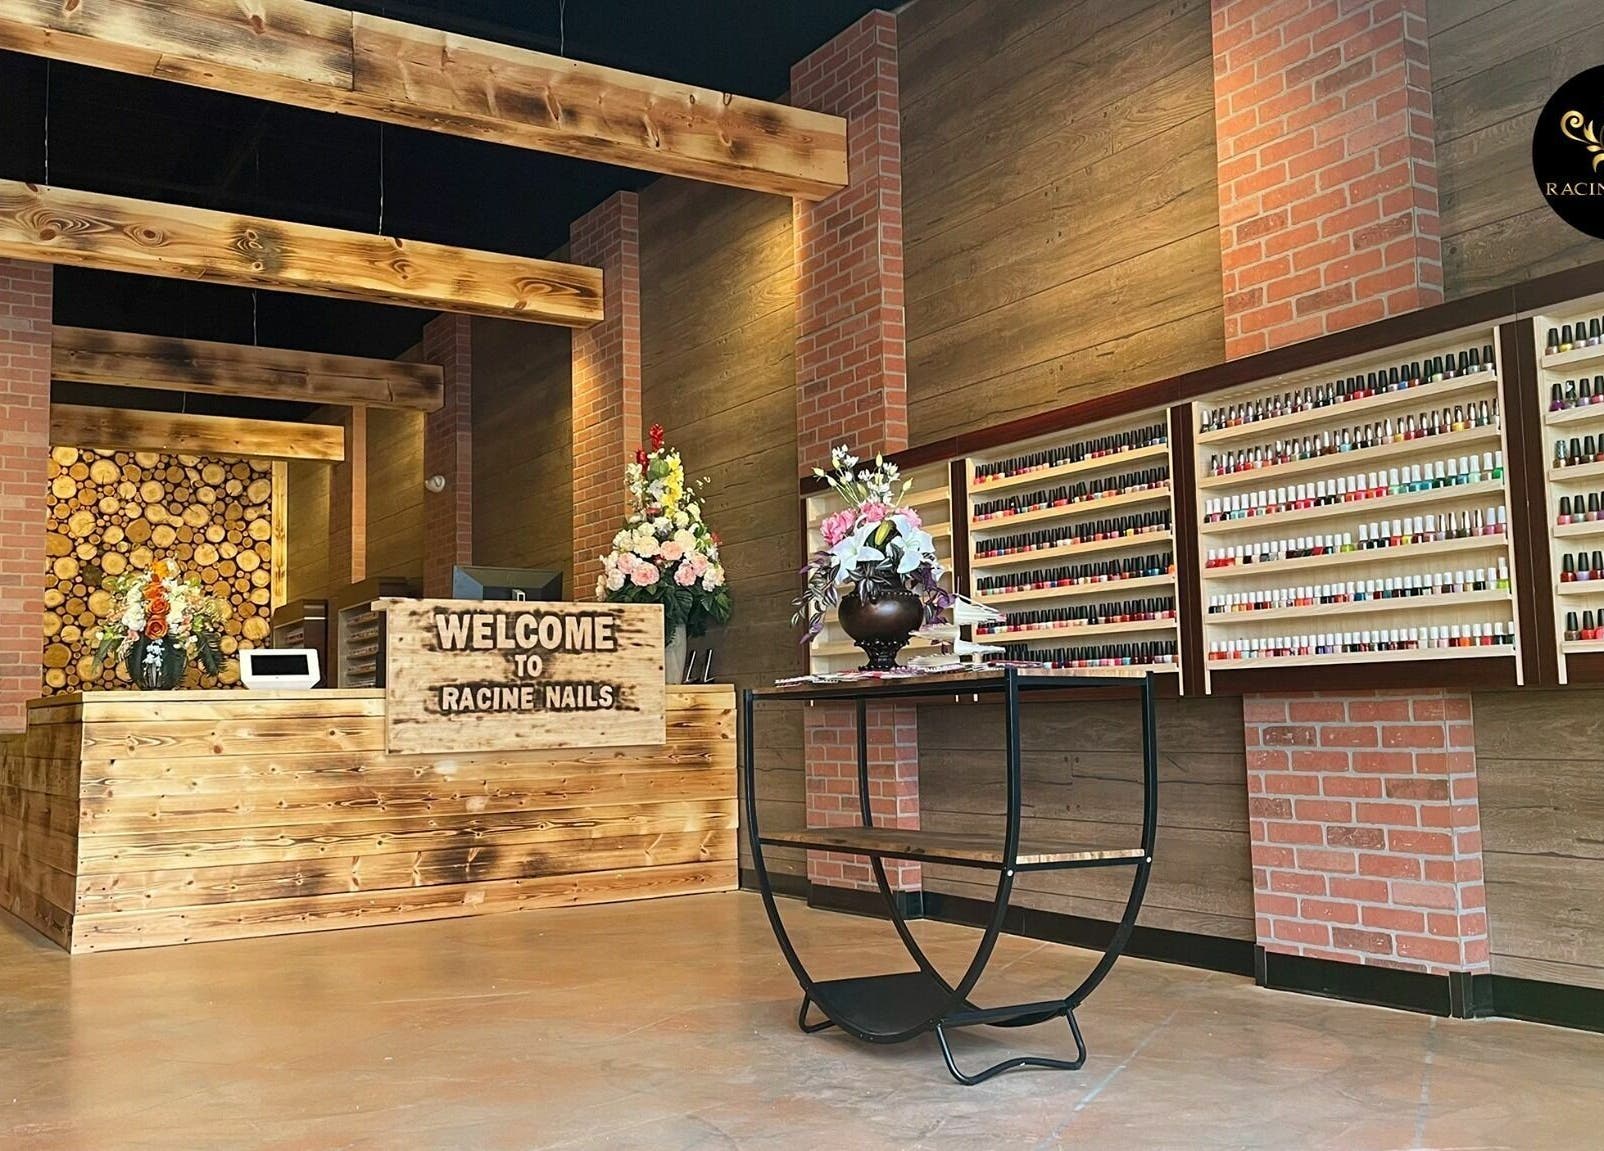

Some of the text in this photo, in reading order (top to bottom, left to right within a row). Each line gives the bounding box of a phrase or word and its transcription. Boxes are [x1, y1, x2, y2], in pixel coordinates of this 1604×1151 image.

[436, 613, 615, 650] WELCOME
[515, 655, 543, 677] TO
[442, 685, 613, 711] RACINE NAILS
